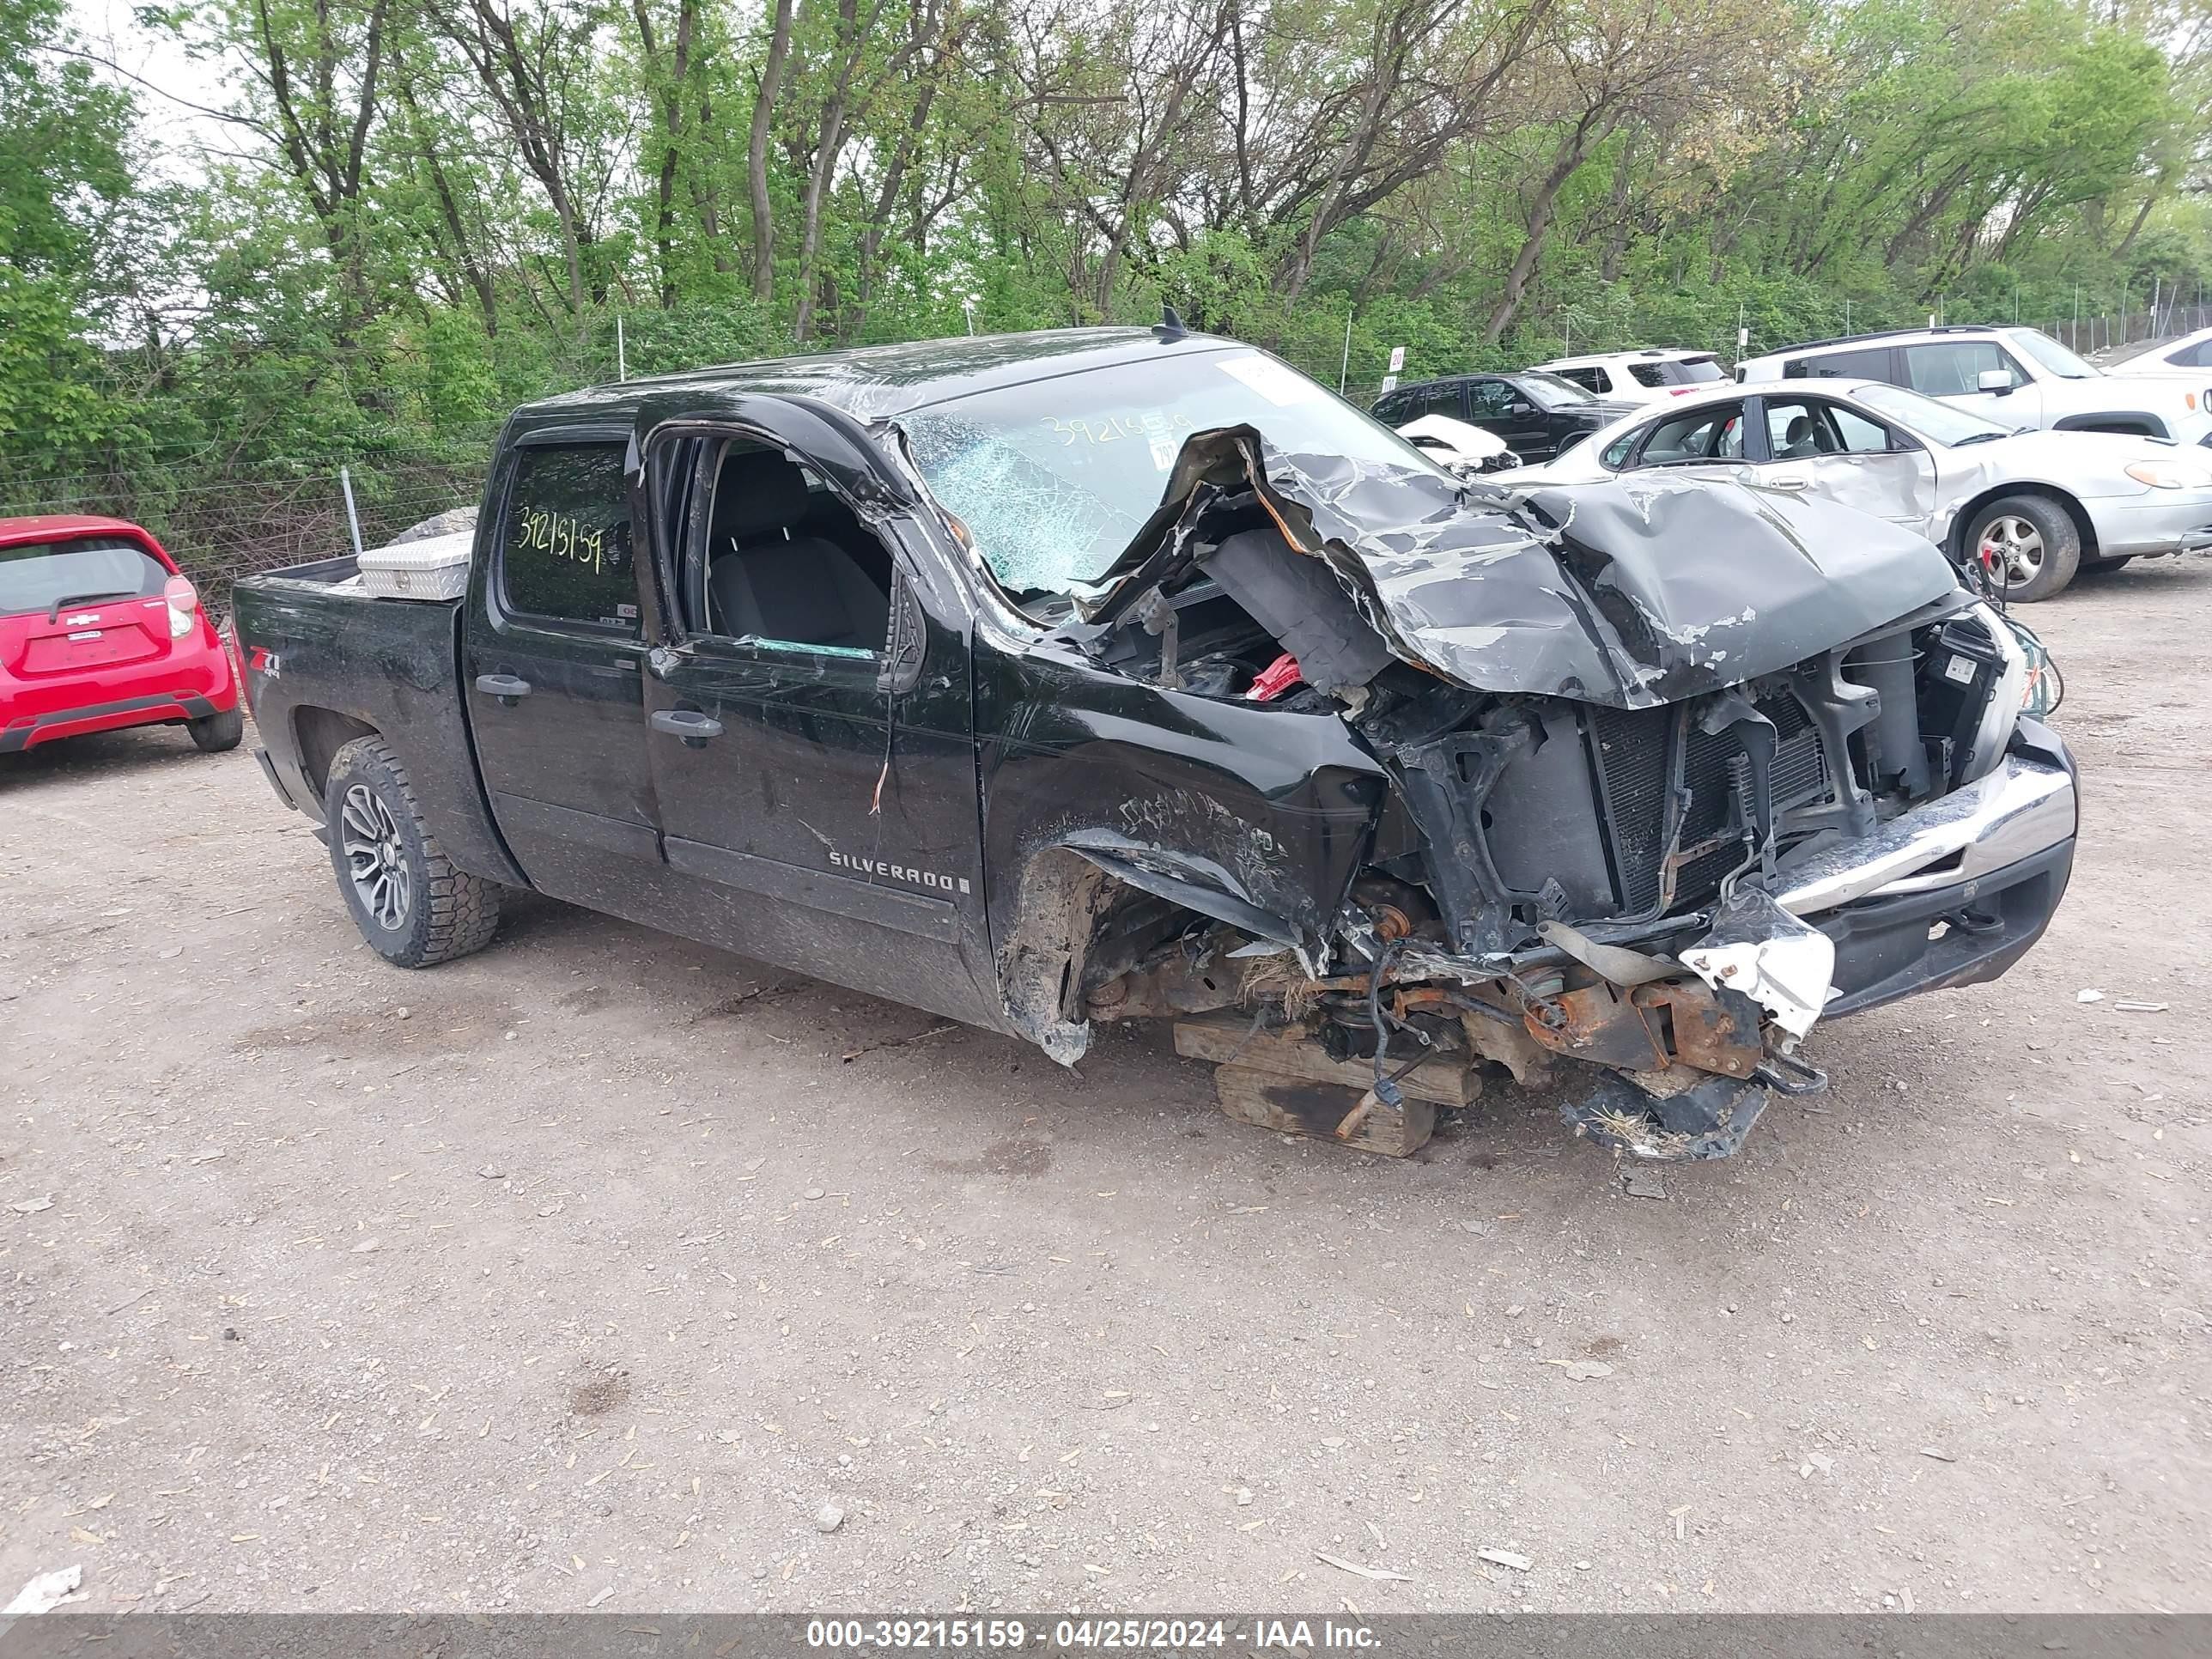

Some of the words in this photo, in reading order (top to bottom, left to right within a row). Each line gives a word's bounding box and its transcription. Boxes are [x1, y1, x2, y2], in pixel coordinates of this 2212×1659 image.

[1392, 353, 1402, 366] 20
[1041, 414, 1197, 447] 392159
[249, 646, 280, 671] Z71
[829, 851, 953, 890] SILVERADO
